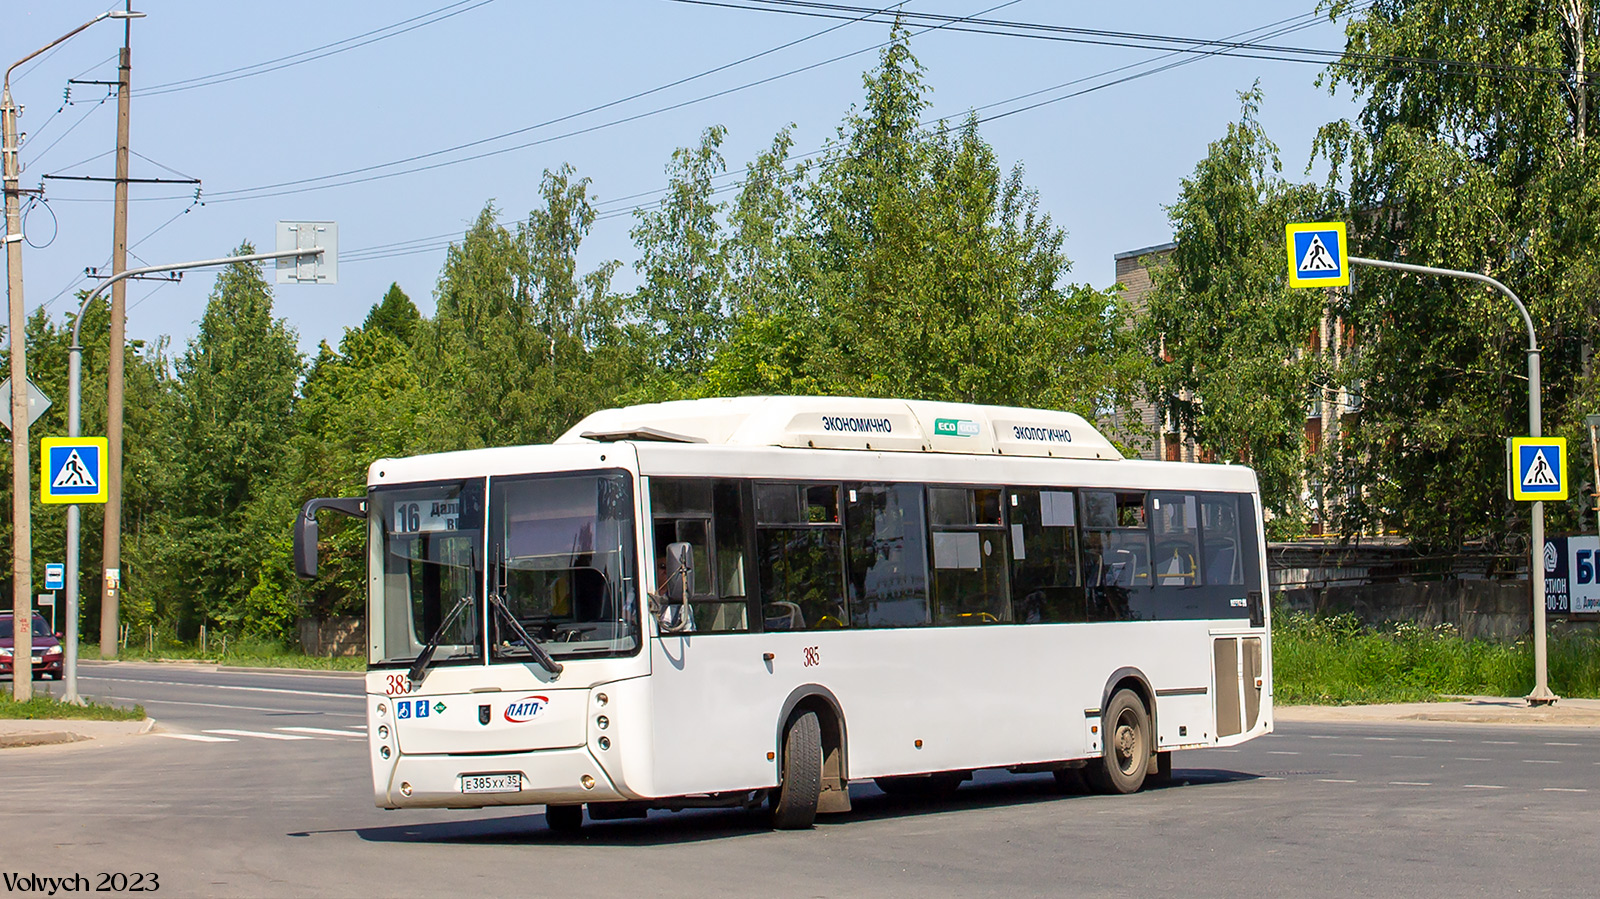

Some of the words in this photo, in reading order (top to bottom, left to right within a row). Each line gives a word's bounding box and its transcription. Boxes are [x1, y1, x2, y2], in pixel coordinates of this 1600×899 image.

[822, 416, 892, 433] ЭКОНОМИЧНО
[1013, 425, 1072, 443] ЭКОЛОГИЧНО
[398, 503, 420, 533] 16
[803, 646, 820, 668] 385
[385, 674, 412, 695] 385
[507, 775, 517, 785] 35
